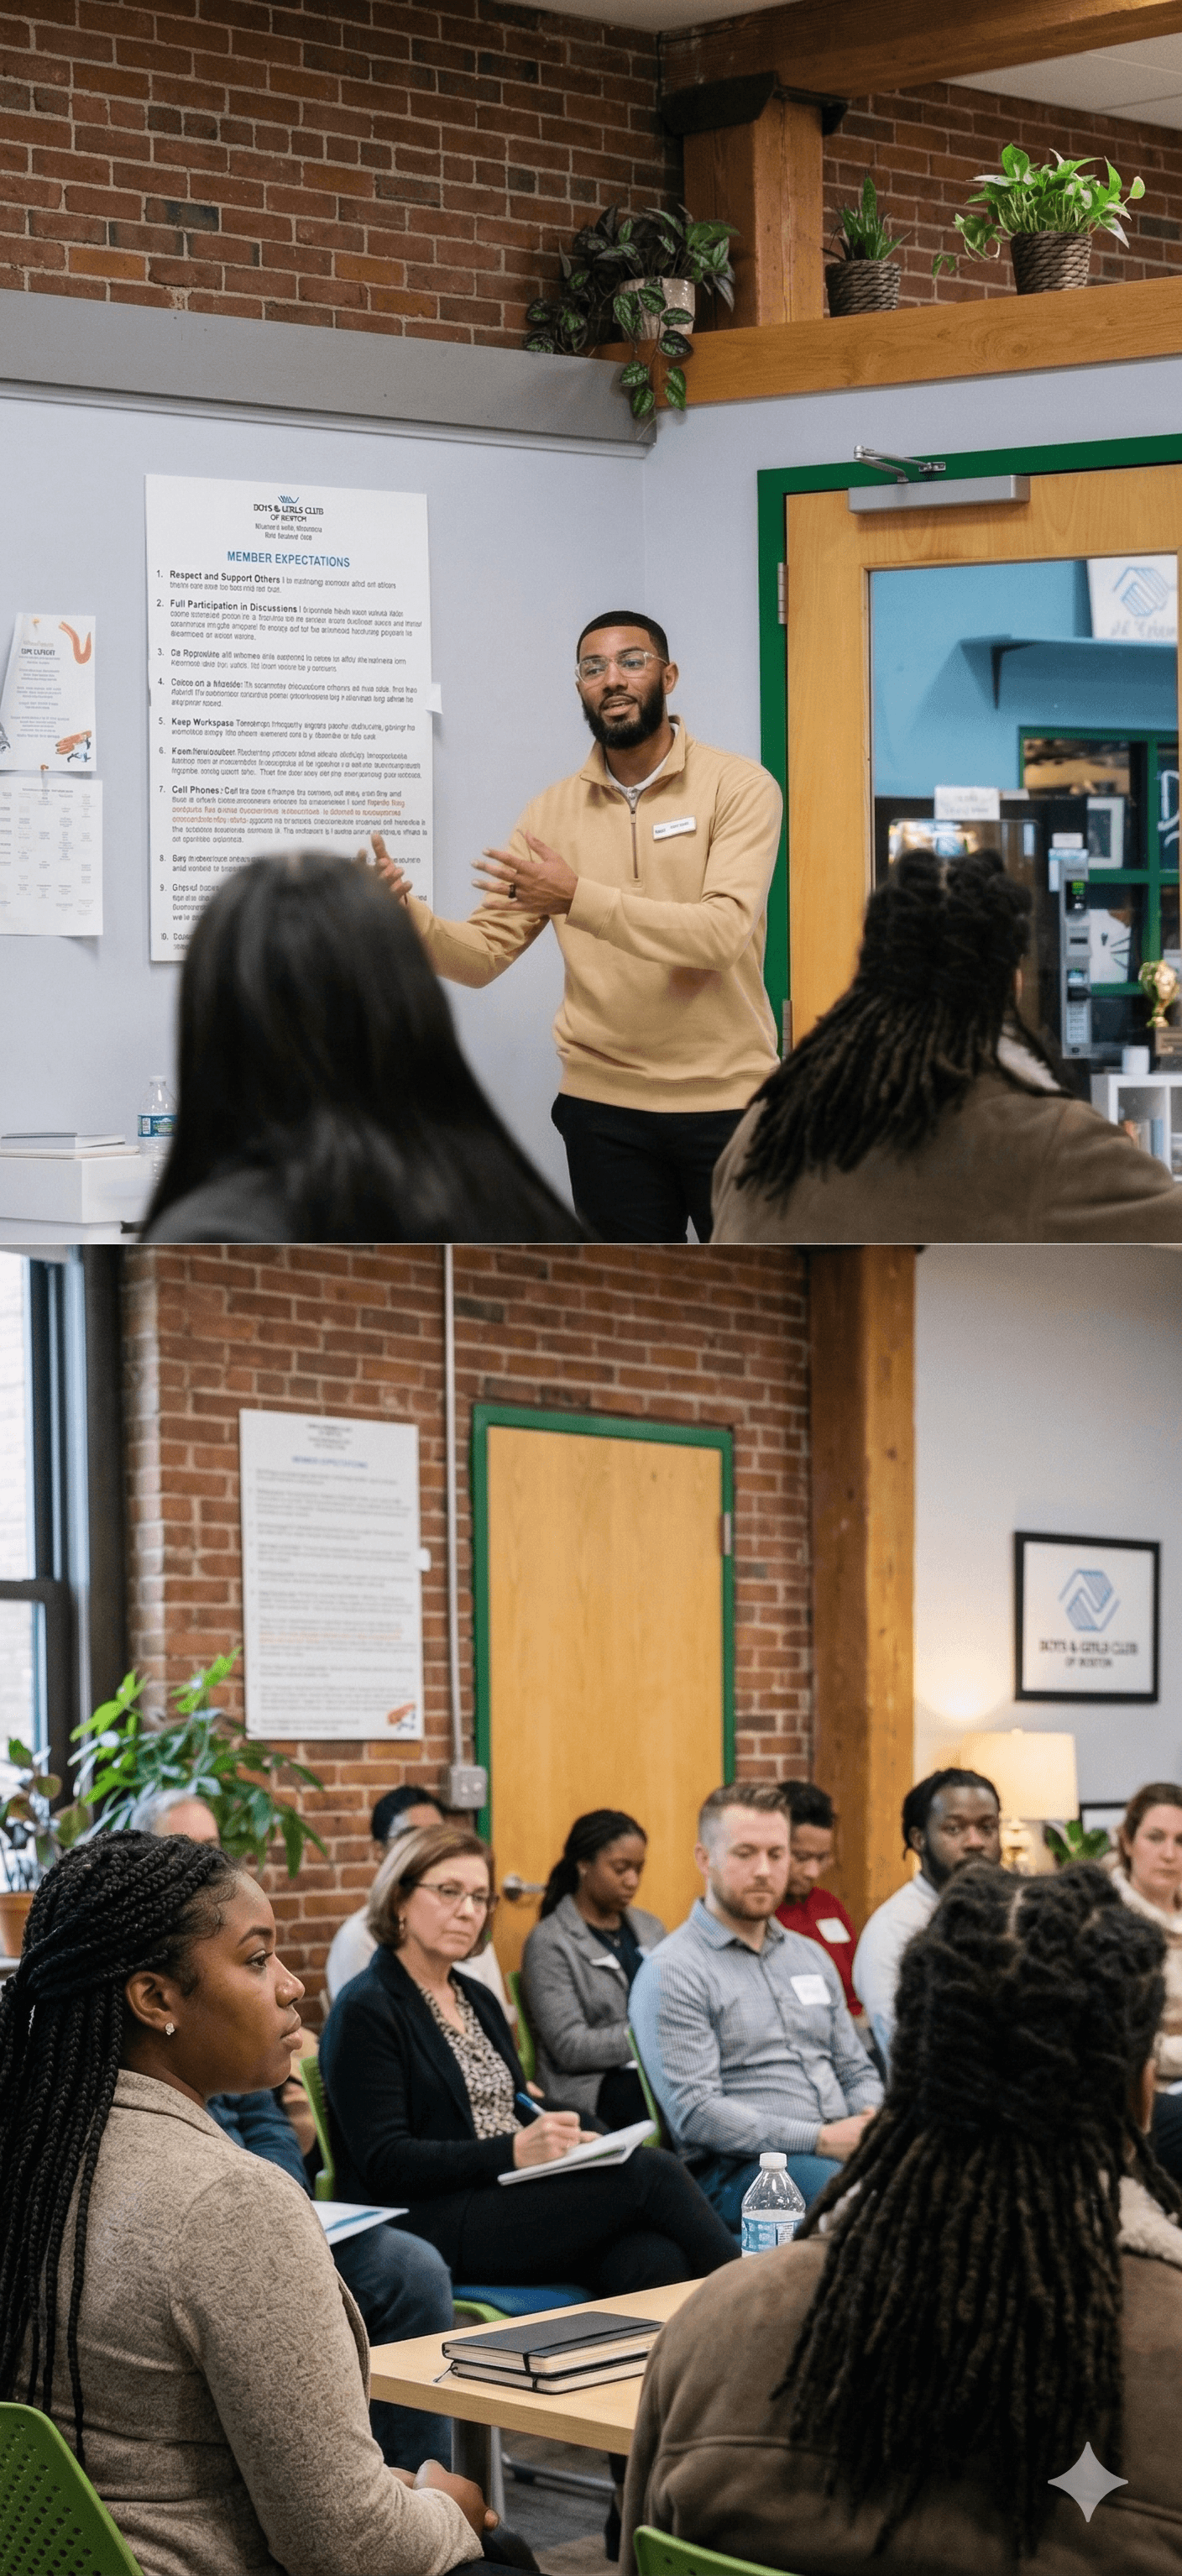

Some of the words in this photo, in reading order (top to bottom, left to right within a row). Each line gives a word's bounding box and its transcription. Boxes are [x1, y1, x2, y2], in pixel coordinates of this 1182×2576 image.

[228, 551, 273, 563] MEMBER
[275, 553, 350, 568] EXPECTATIONS
[156, 569, 163, 578] 1.
[170, 570, 202, 581] Respect
[204, 573, 219, 581] and
[221, 573, 253, 584] Support
[254, 574, 280, 584] Others
[156, 599, 164, 607] 2.
[170, 599, 186, 608] Full
[187, 599, 238, 611] Participation
[240, 602, 248, 611] in
[158, 648, 165, 657] 3.
[158, 717, 165, 725] 5.
[159, 746, 166, 755] 6.
[159, 785, 166, 793] 7.
[171, 785, 188, 794] Cell
[160, 854, 166, 862] 8.
